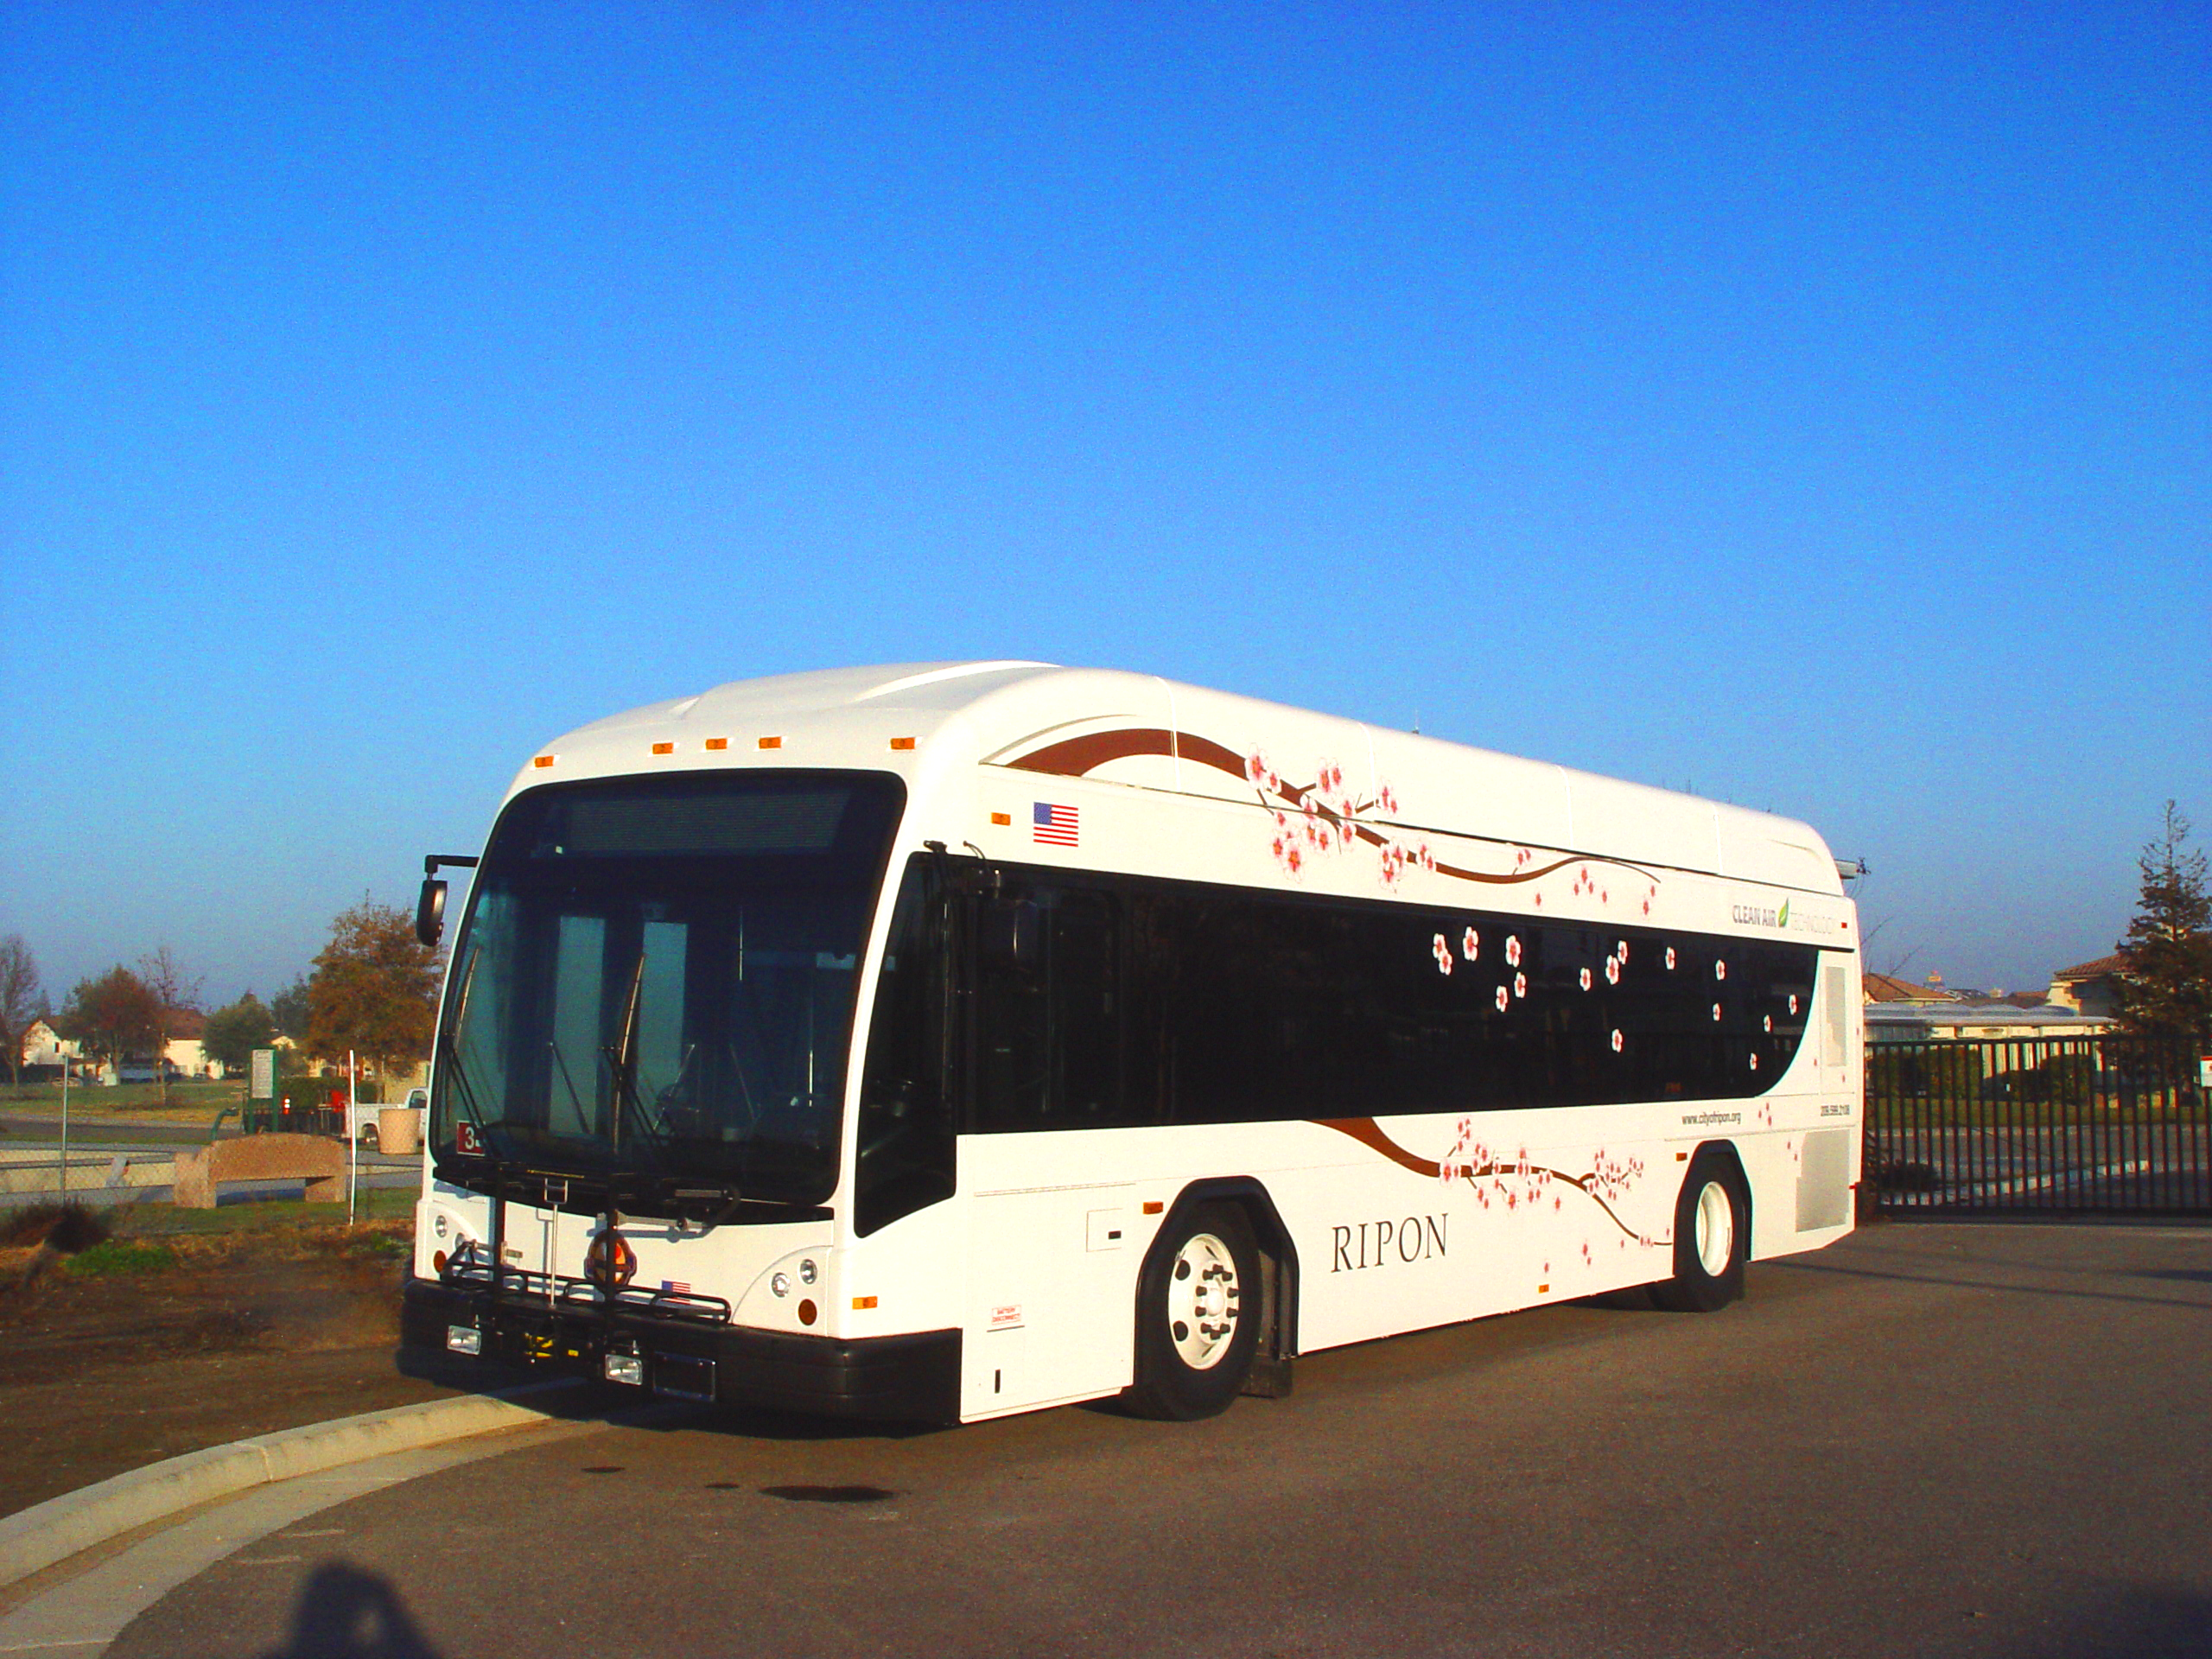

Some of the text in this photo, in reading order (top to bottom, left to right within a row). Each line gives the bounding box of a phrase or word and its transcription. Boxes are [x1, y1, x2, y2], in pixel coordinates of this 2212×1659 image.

[1732, 905, 1760, 925] CLEAN
[1762, 908, 1777, 927] AIR
[1331, 1213, 1448, 1273] RIPON
